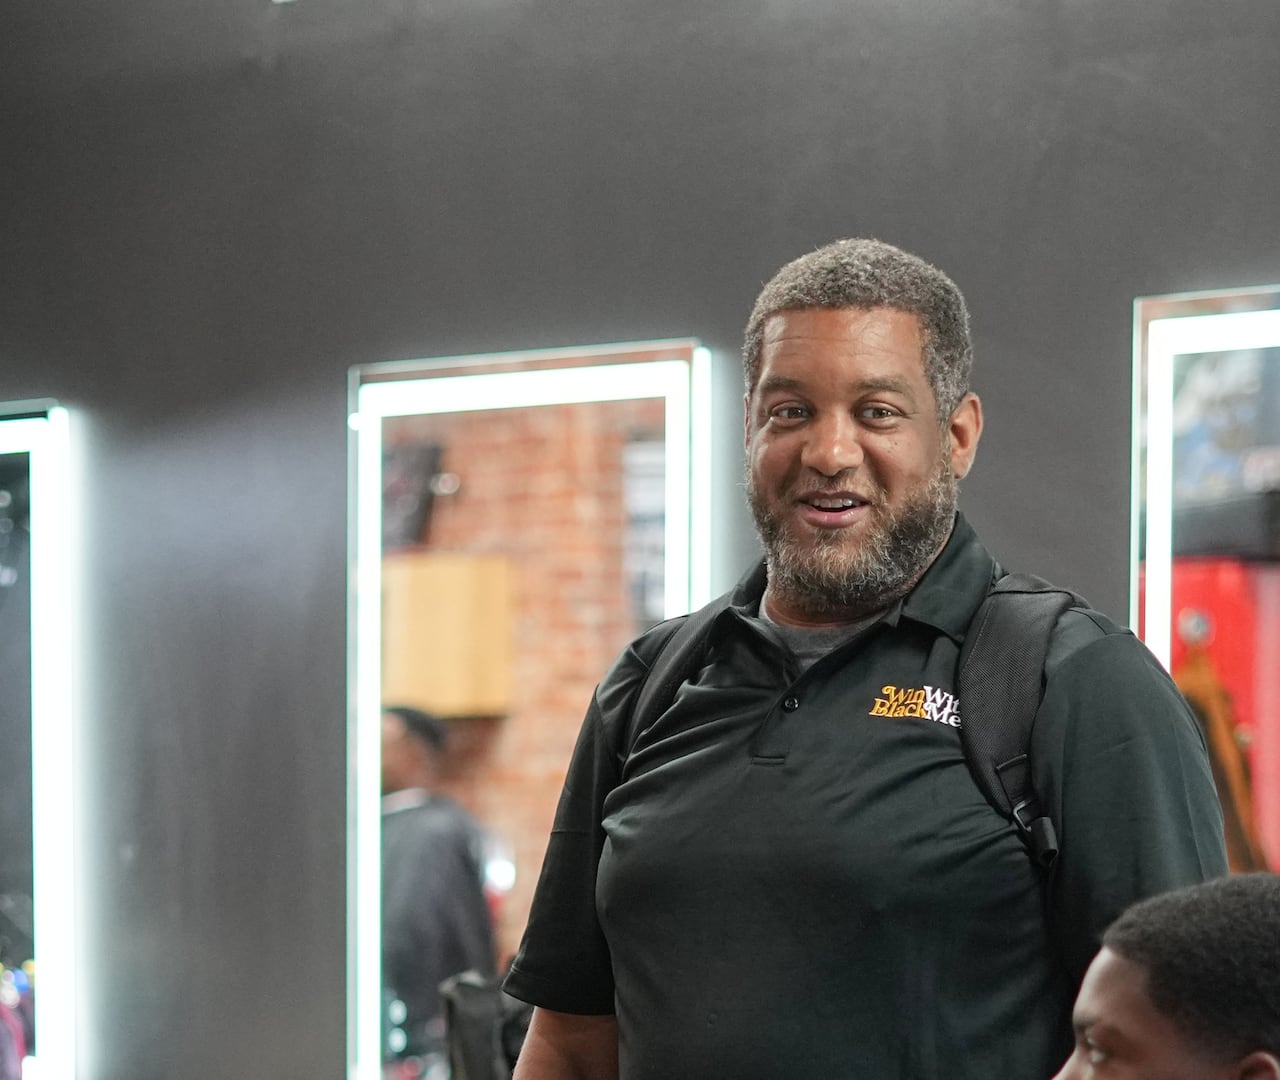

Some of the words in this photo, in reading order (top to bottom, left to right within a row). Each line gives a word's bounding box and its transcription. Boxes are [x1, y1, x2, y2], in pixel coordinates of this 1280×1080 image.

[868, 698, 927, 718] Black
[923, 702, 962, 730] Me
[882, 685, 926, 705] Win
[923, 685, 961, 714] Wit
